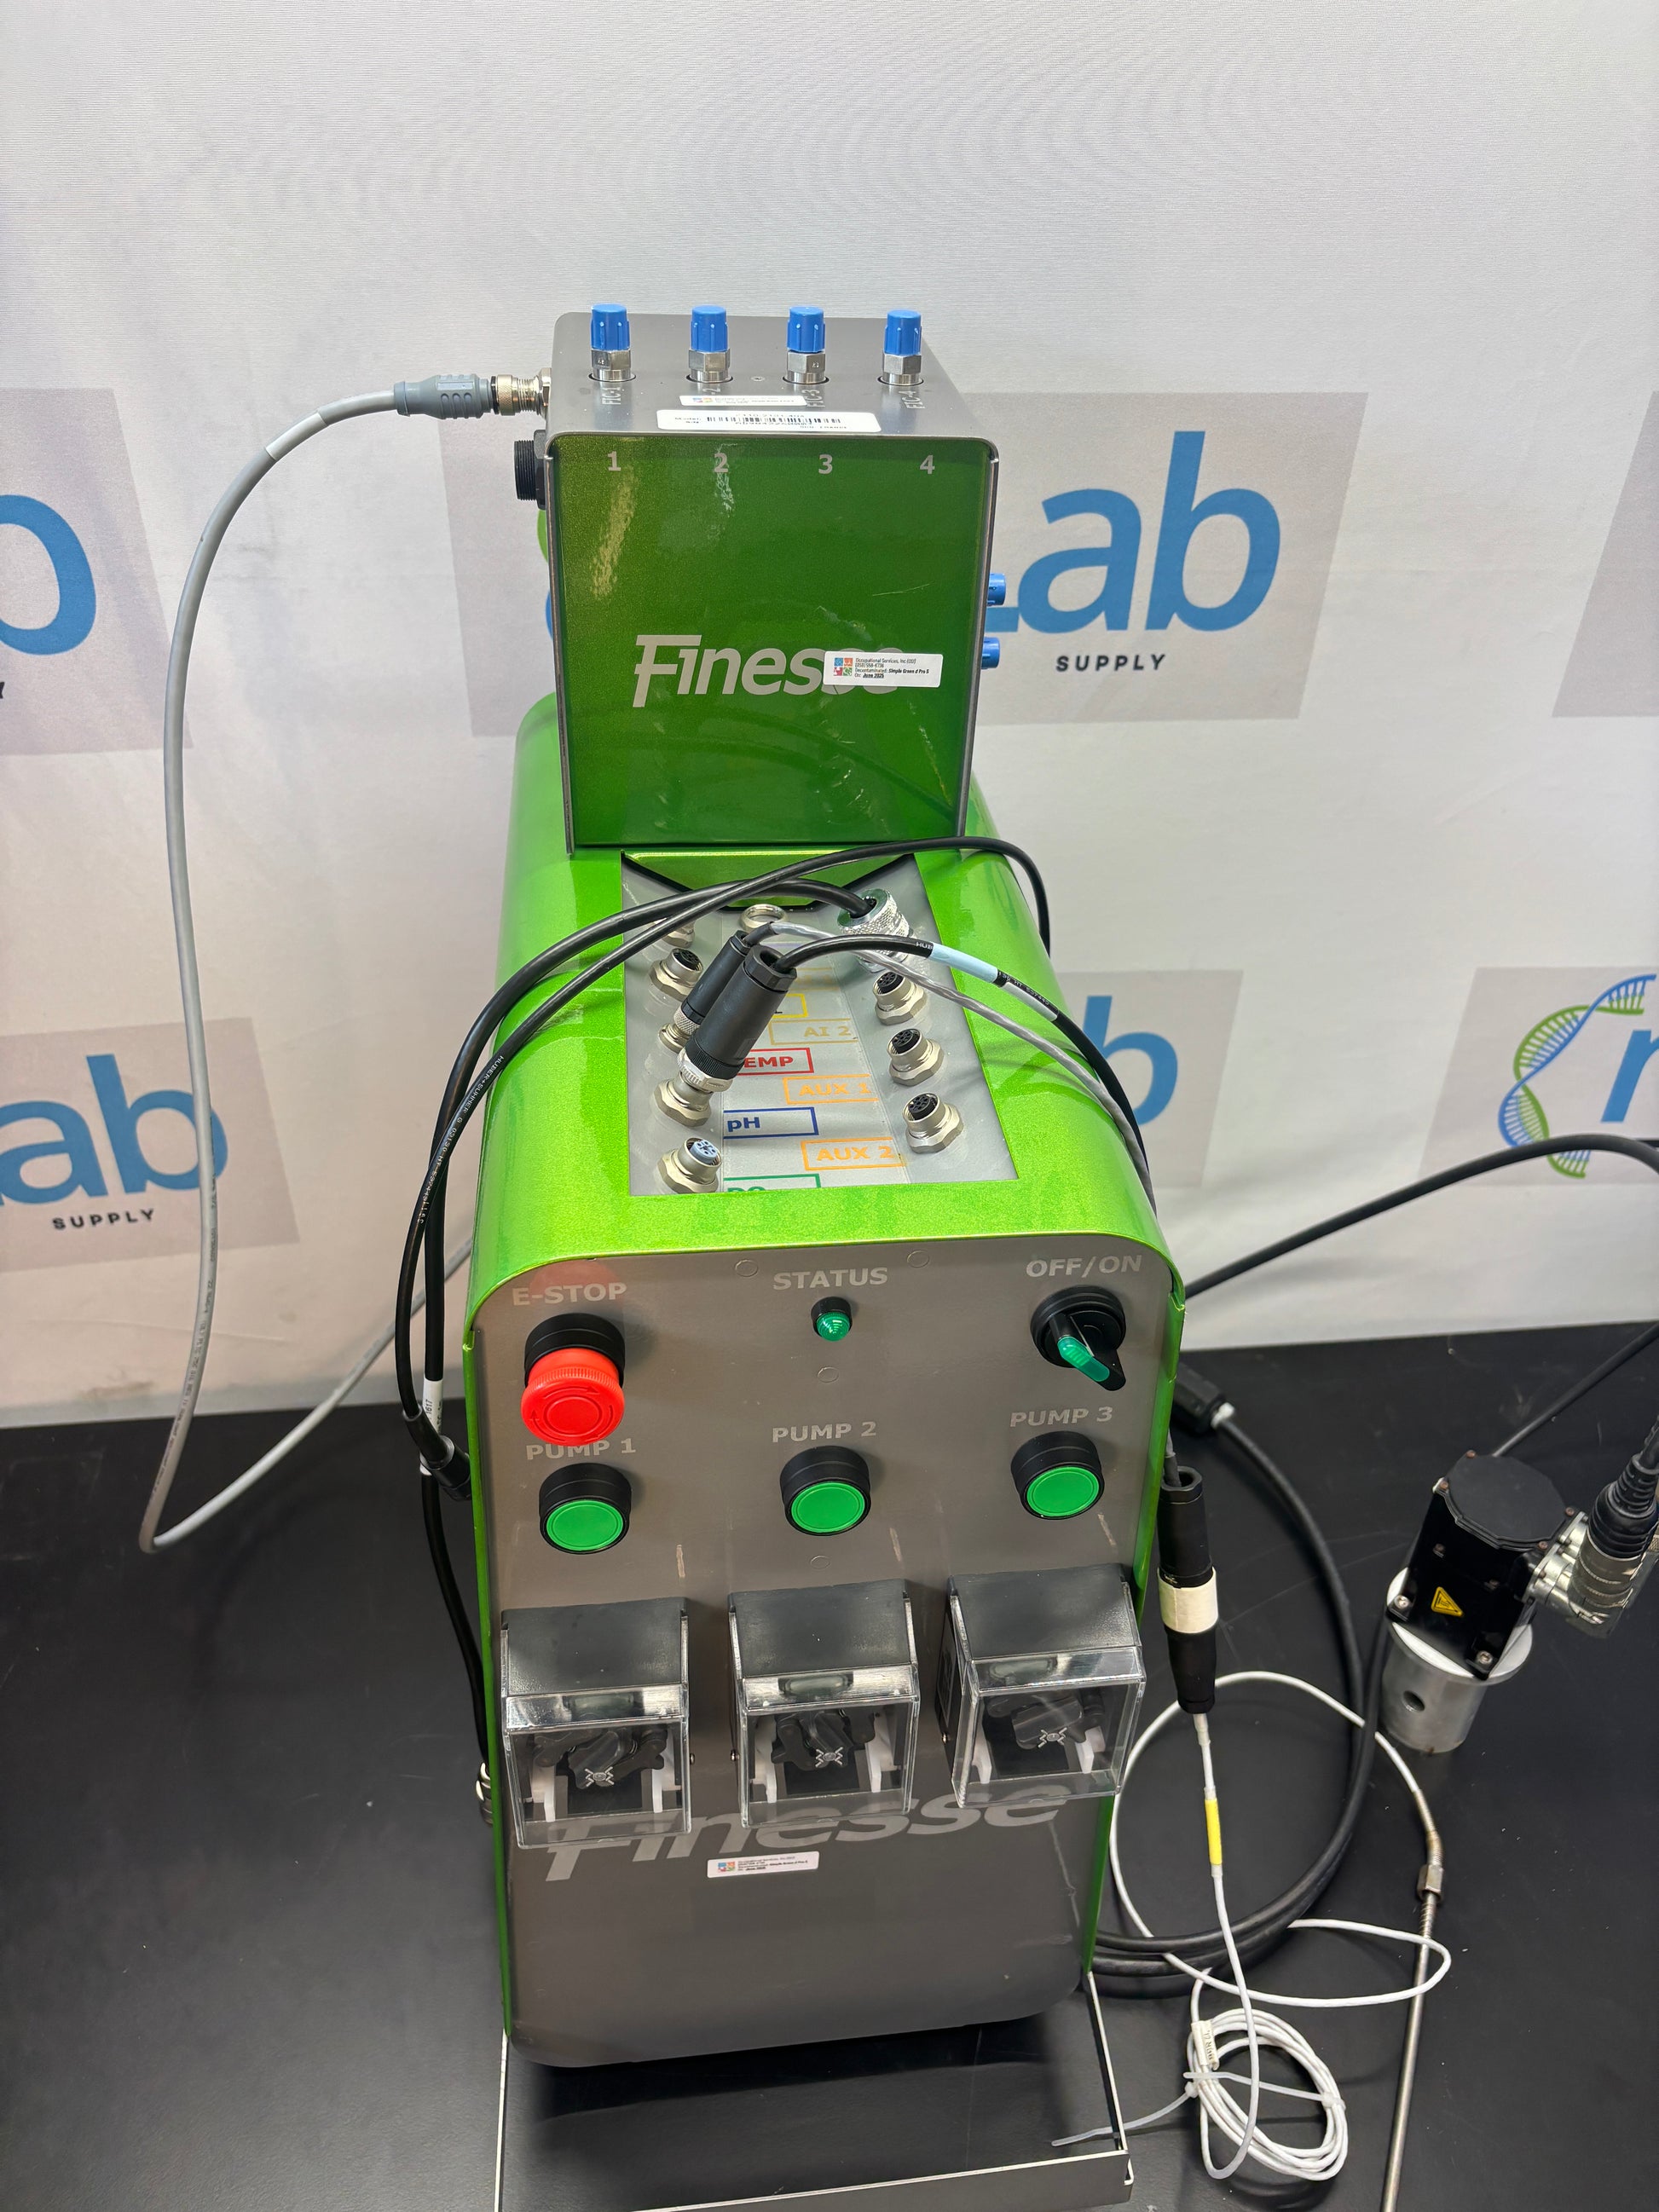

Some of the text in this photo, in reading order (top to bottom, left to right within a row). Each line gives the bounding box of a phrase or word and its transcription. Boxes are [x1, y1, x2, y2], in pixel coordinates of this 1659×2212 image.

[607, 452, 621, 471] 1
[714, 453, 729, 473] 2
[818, 453, 833, 475] 3
[919, 455, 935, 475] 4
[986, 430, 1281, 634] ab
[633, 634, 905, 709] Fines
[1055, 654, 1166, 673] SUPPLY
[838, 1025, 852, 1037] 2
[743, 1056, 794, 1068] EMP
[799, 1083, 872, 1096] AUX 1
[0, 1054, 228, 1206] ab
[727, 1117, 760, 1133] pH
[816, 1146, 894, 1161] AUX 2
[52, 1208, 155, 1231] SUPPLY
[1026, 1254, 1142, 1278] OFF/ON
[772, 1267, 888, 1291] STATUS
[512, 1282, 627, 1306] E-STOP
[1010, 1406, 1113, 1428] PUMP 3
[772, 1421, 877, 1443] PUMP 2
[526, 1438, 637, 1460] PUMP 1
[546, 1784, 1072, 1882] Finesse
